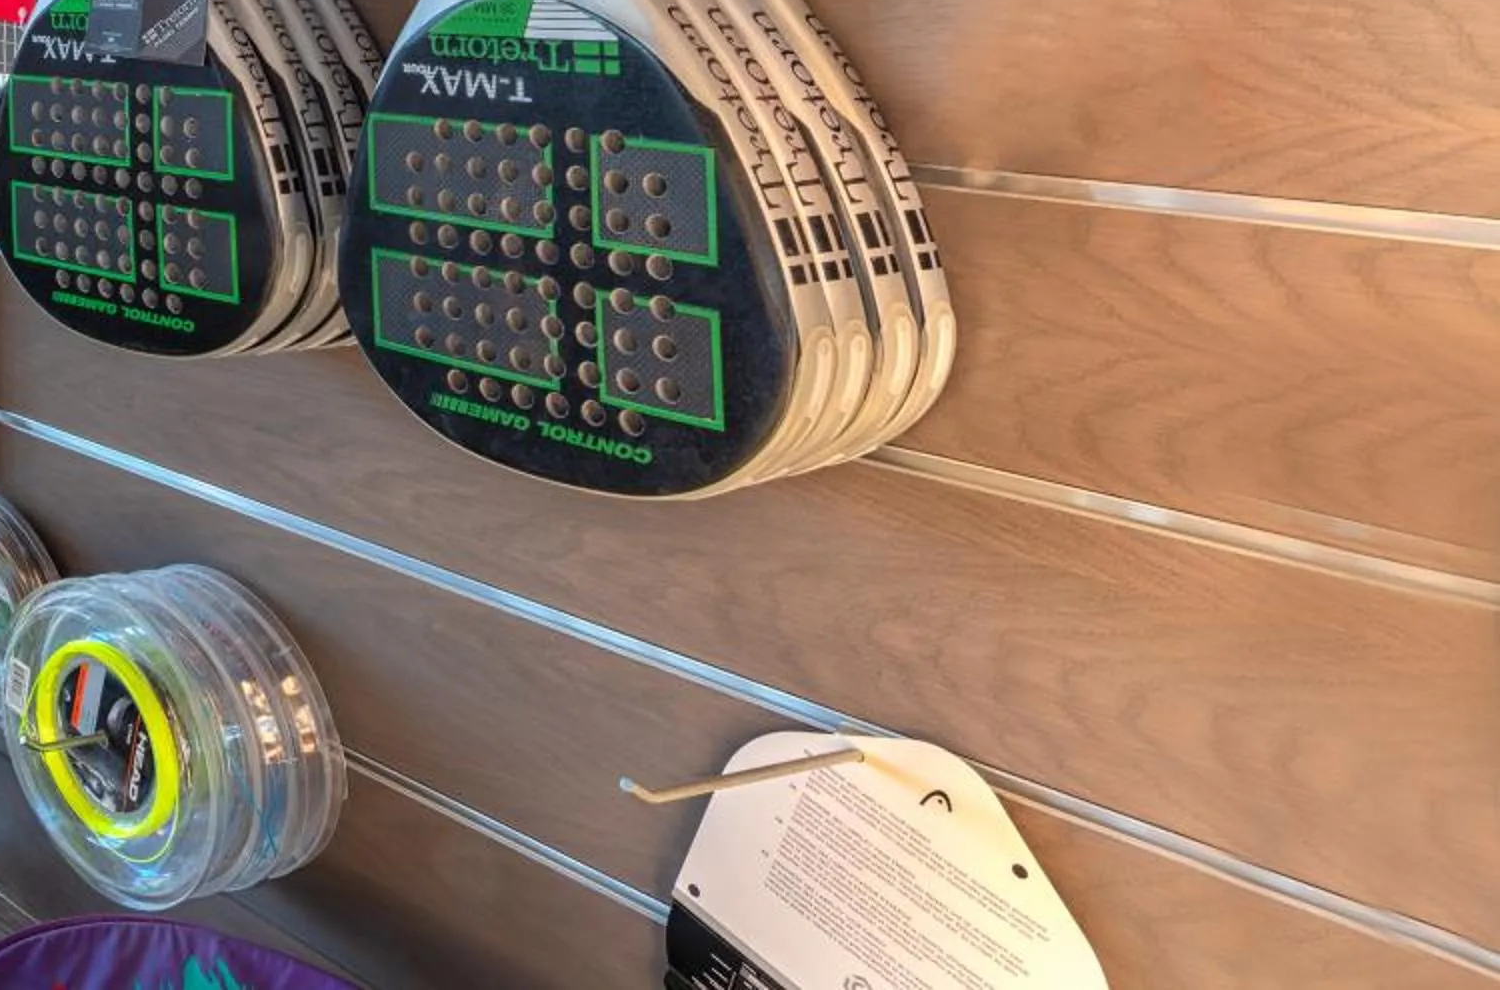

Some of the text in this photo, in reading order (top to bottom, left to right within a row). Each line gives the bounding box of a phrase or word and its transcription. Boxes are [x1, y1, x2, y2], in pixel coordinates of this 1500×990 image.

[420, 65, 533, 103] T-MAX
[428, 35, 570, 73] Tretorn
[668, 6, 784, 208] Tretorn
[708, 6, 820, 207] Tretorn
[753, 11, 867, 204] Tretorn
[805, 14, 910, 200] Tretorn
[129, 307, 195, 334] CONTROL
[535, 420, 653, 466] CONTROL
[129, 731, 150, 803] HEAD
